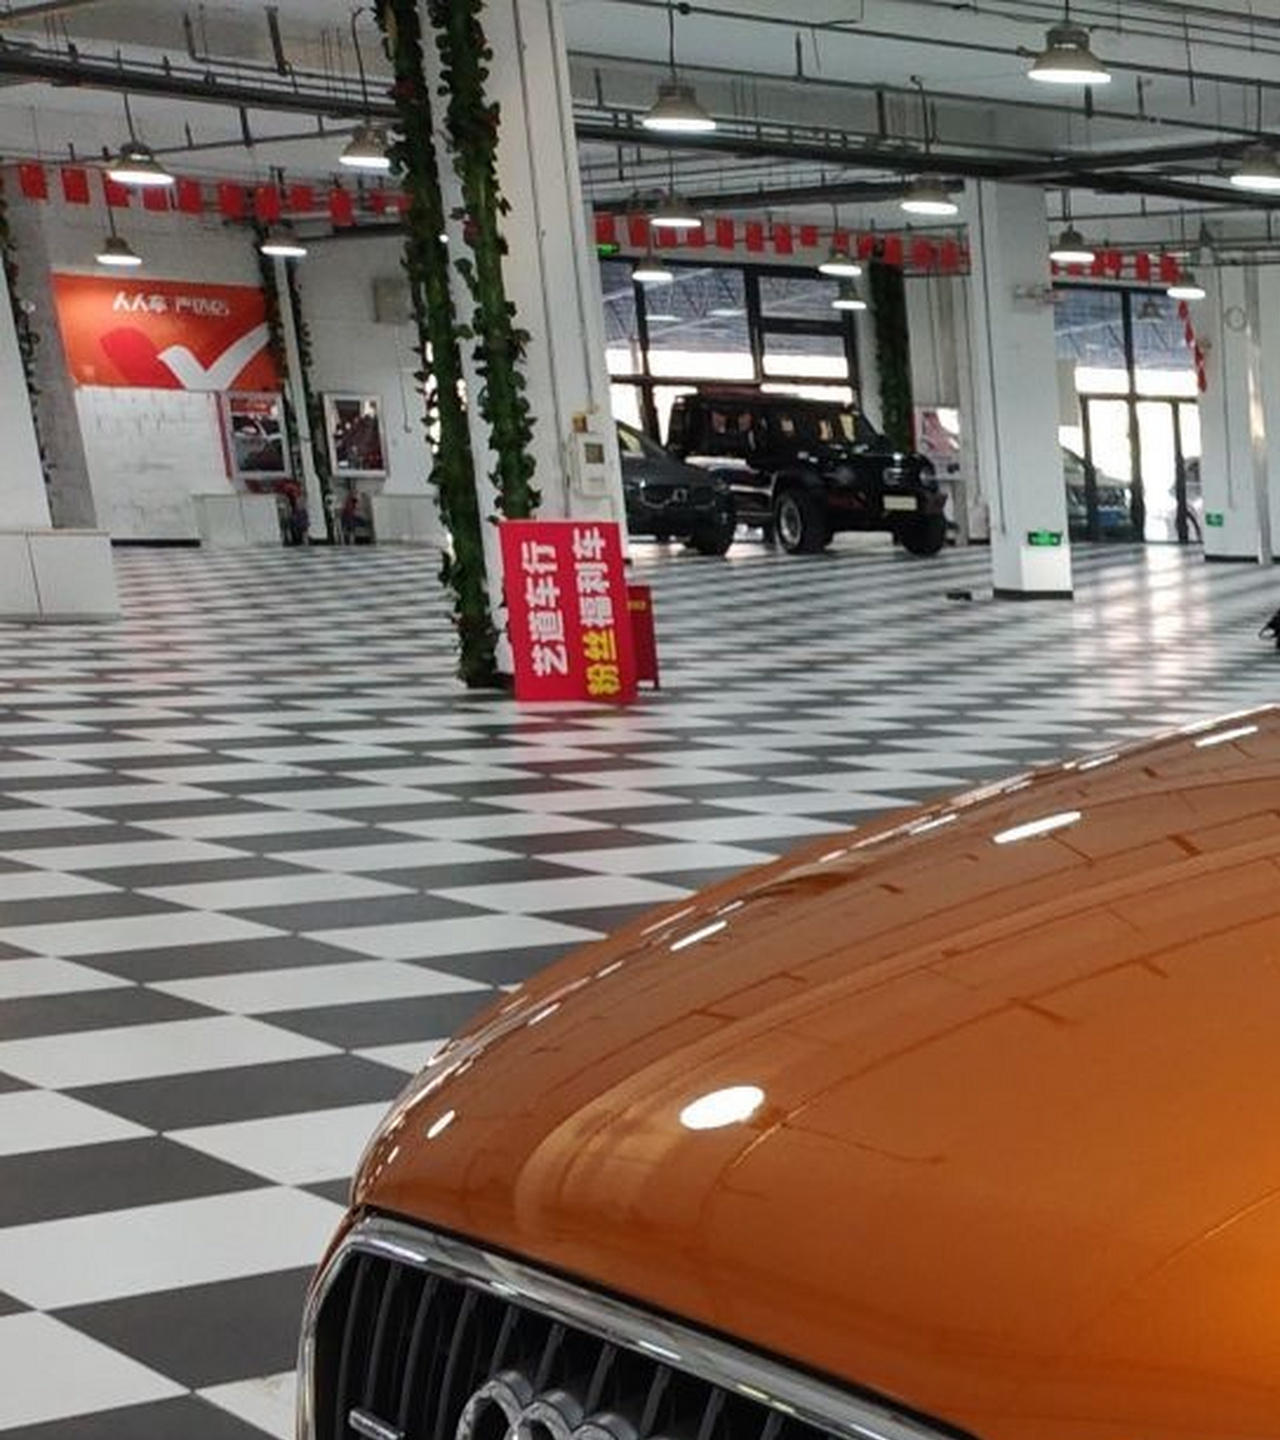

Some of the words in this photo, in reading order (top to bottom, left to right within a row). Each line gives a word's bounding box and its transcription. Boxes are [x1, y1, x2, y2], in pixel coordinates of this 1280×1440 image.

[521, 540, 569, 677] 艺道车行
[572, 526, 621, 696] 粉丝福利车
